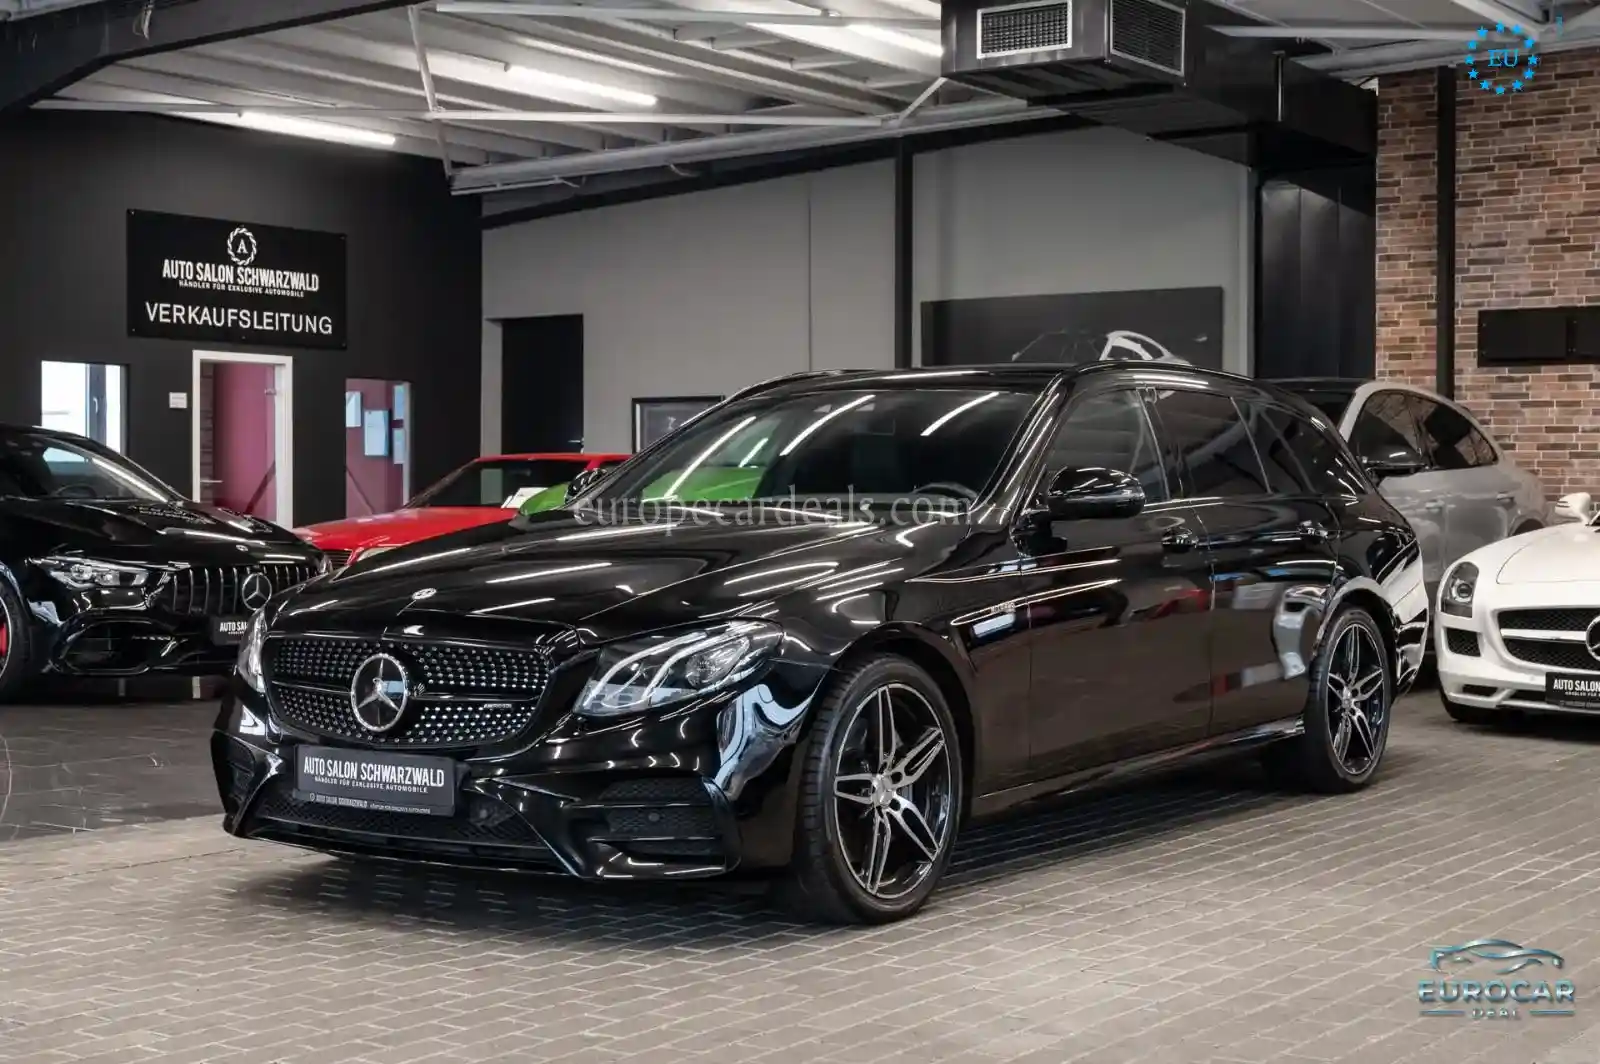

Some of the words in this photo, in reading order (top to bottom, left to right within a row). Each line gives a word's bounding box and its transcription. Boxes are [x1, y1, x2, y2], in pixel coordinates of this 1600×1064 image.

[236, 239, 248, 254] A
[162, 259, 194, 280] AUTO
[196, 262, 234, 284] SALON
[237, 266, 319, 292] SCHWARZWALD
[265, 288, 304, 297] AUTOMOBILE
[146, 301, 333, 335] VERKAUFSLEITUNG
[219, 621, 236, 632] AUTO
[1553, 679, 1574, 690] AUTO
[303, 756, 325, 775] AUTO
[327, 759, 358, 779] SALON
[360, 763, 445, 787] SCHWARZWALD
[386, 785, 428, 793] AUTOMOBILE
